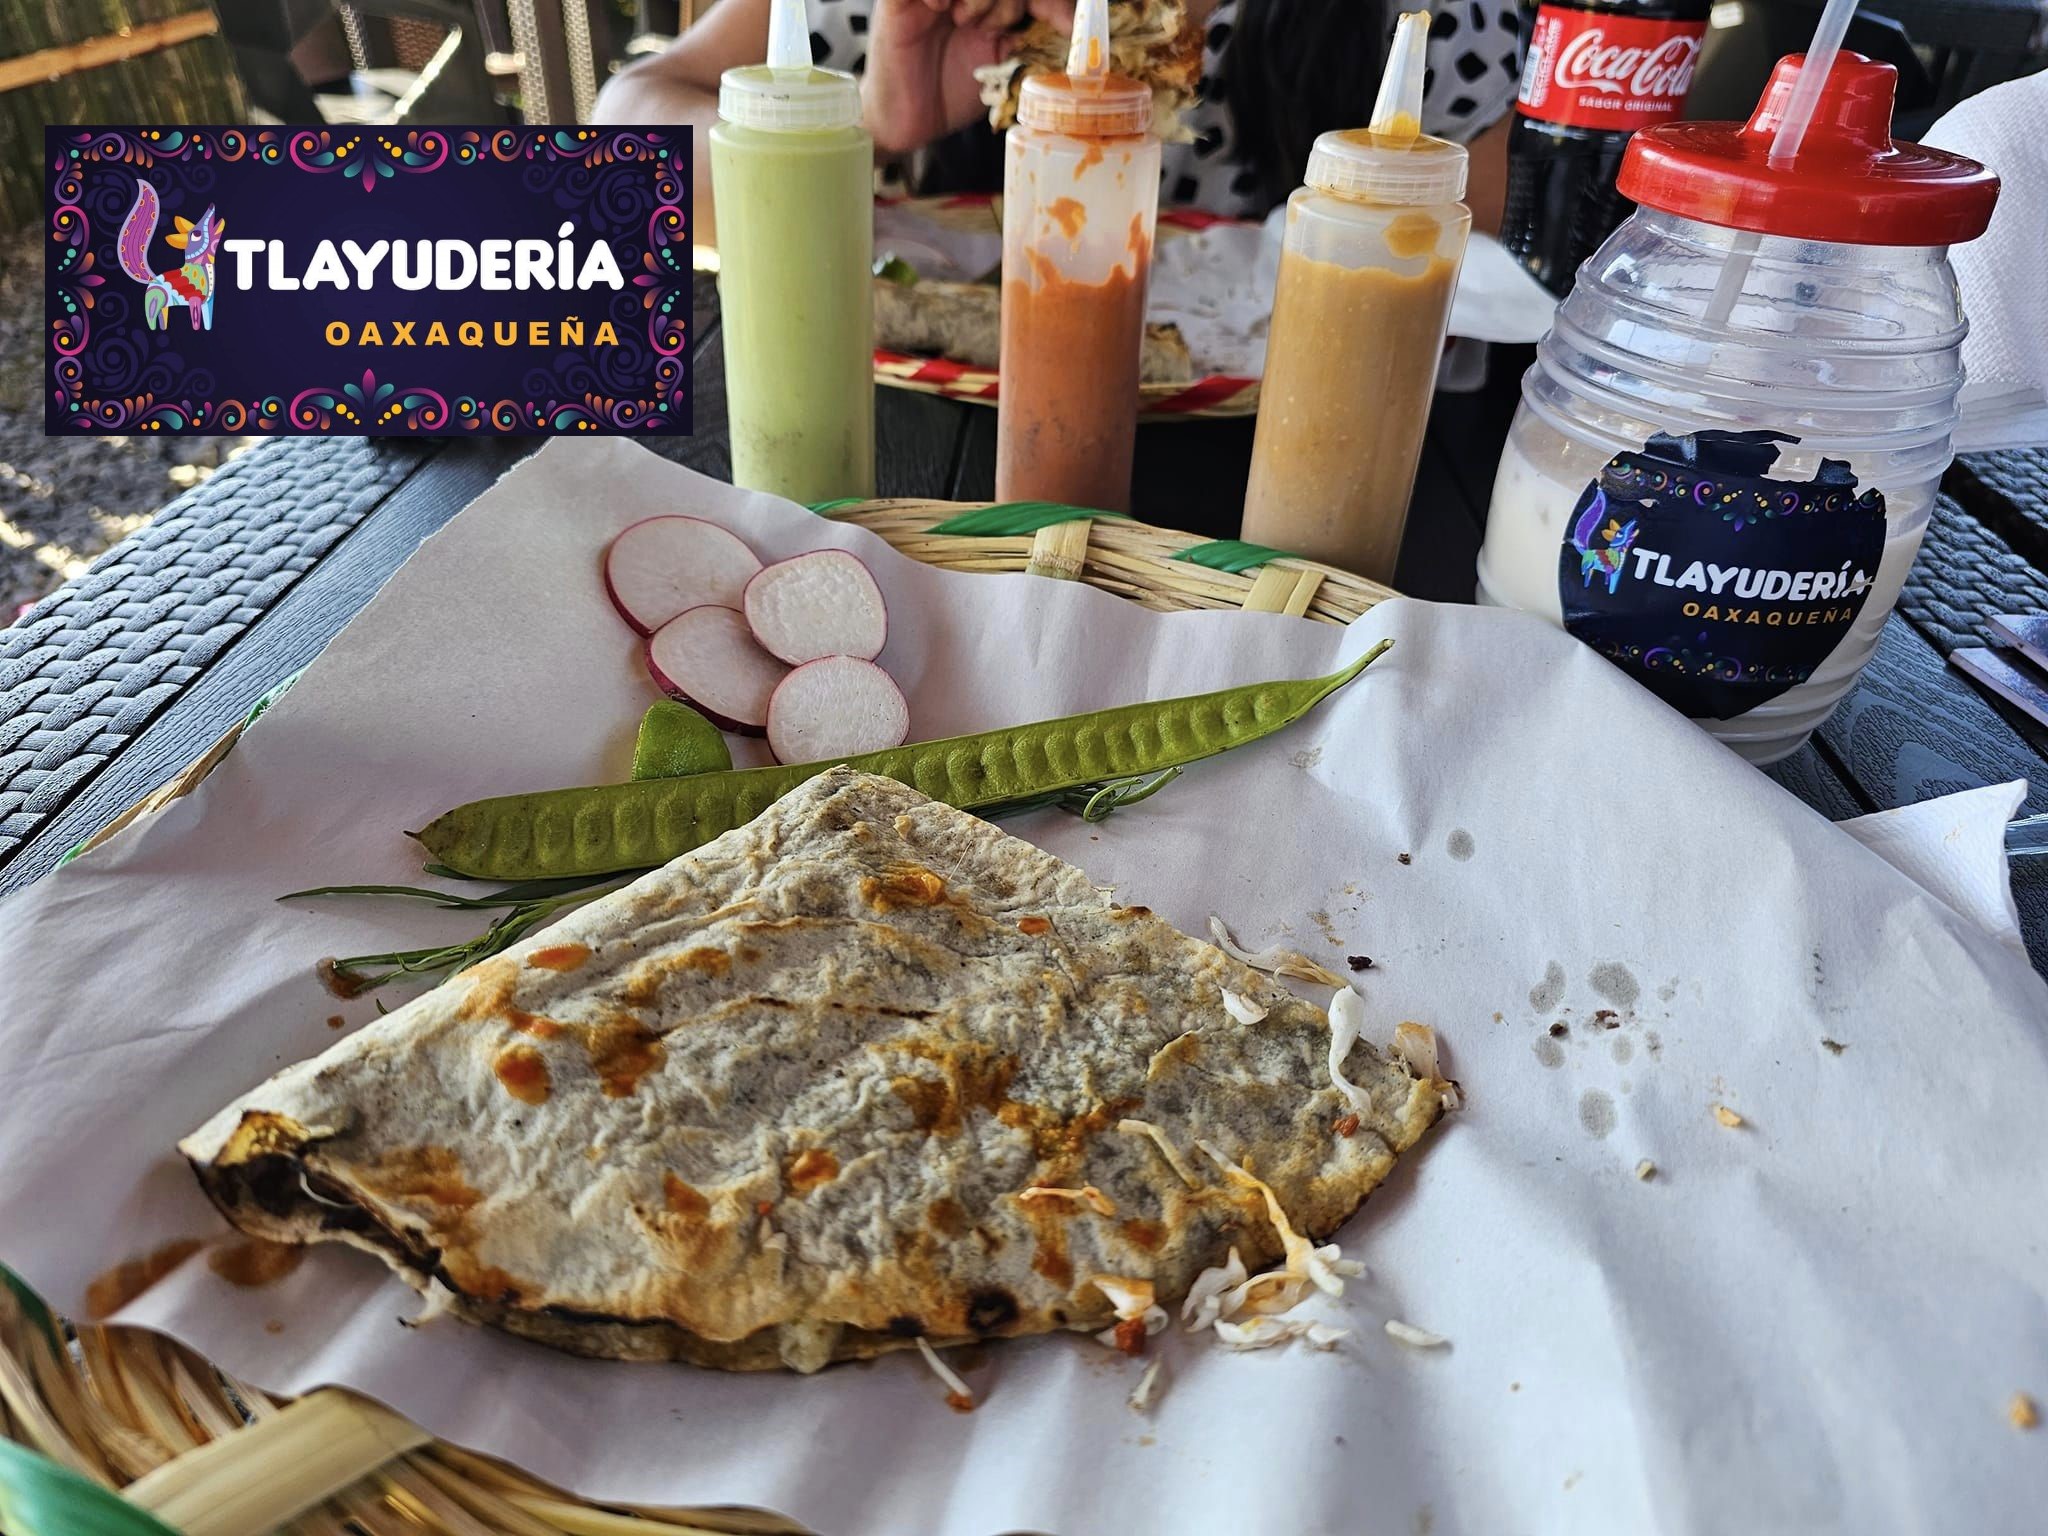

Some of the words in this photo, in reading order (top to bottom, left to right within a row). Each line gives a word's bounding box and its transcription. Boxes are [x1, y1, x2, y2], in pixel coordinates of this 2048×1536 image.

[1554, 28, 1702, 96] Coca-Cola
[1578, 94, 1620, 111] SABOR
[1624, 99, 1672, 112] ORIGINAL
[1632, 547, 1867, 601] TLAYUDERÍA
[1682, 602, 1852, 625] OAXAQUEÑA
